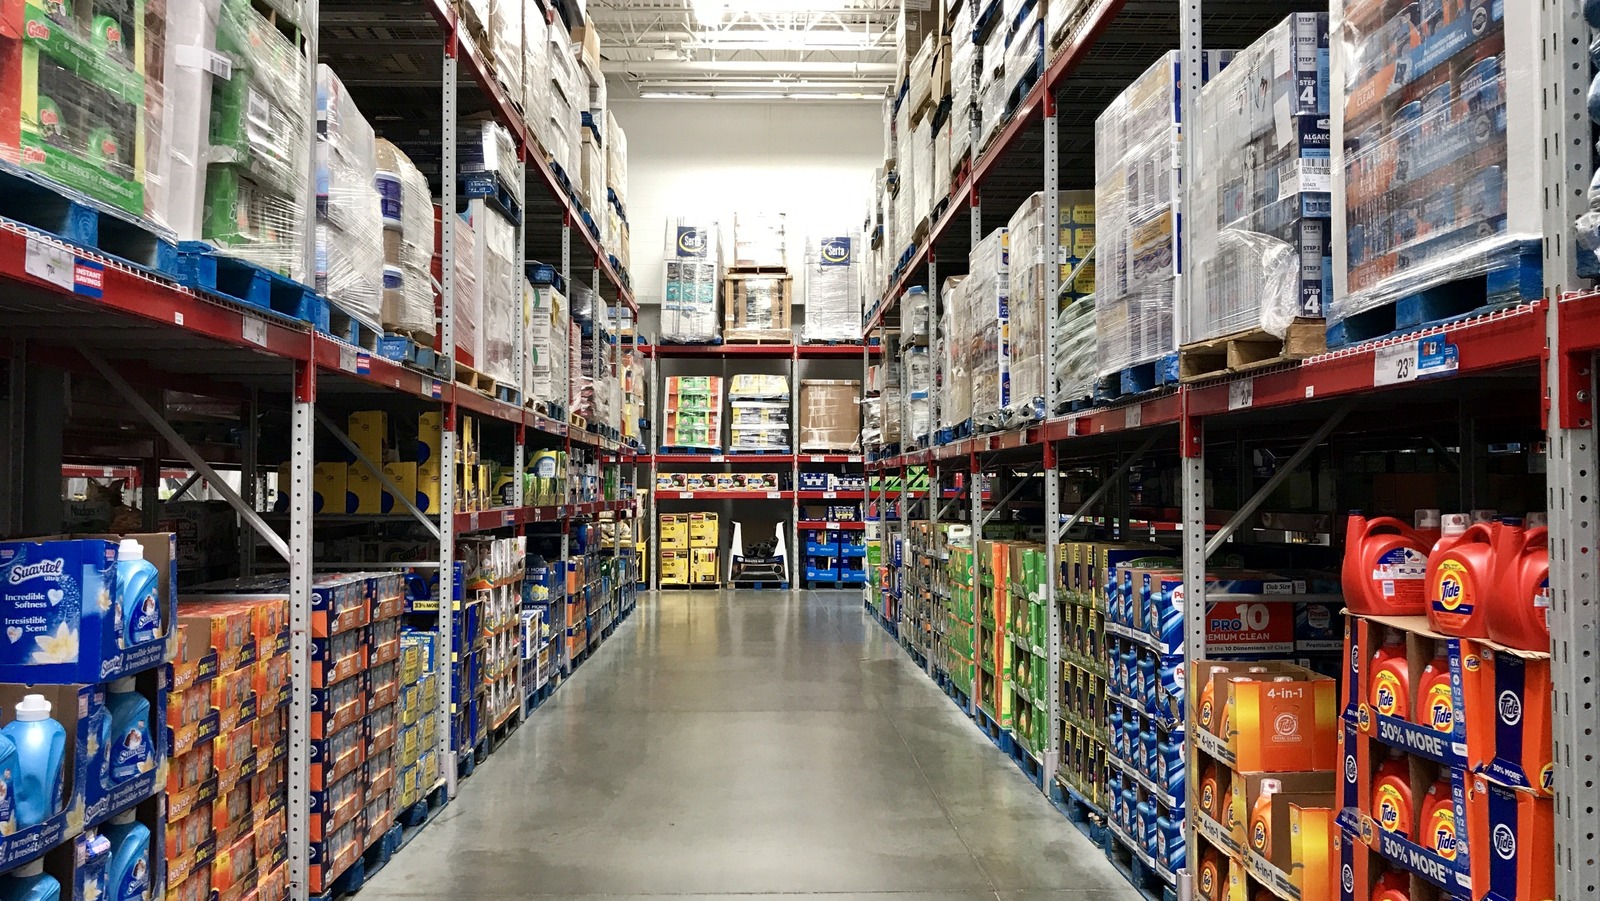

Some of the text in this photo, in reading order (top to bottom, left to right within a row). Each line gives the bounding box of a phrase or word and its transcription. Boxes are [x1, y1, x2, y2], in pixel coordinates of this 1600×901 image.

[1300, 86, 1316, 105] 4
[1357, 89, 1376, 106] CLEAN
[828, 245, 845, 257] Serta
[75, 267, 102, 280] INSTANT
[75, 274, 102, 287] SAVINGS
[1304, 294, 1320, 313] 4
[10, 559, 63, 584] Suavitel
[5, 592, 46, 602] Incredible
[1442, 580, 1460, 602] Tide
[14, 601, 47, 609] Softness
[5, 616, 47, 625] Irresistible
[1211, 618, 1242, 631] PRO
[1235, 603, 1270, 631] 10
[25, 624, 48, 633] Scent
[1239, 632, 1270, 640] CLEAN
[1451, 657, 1460, 667] 6X
[1466, 659, 1480, 668] Tide
[1267, 687, 1303, 699] 4-in-1
[1378, 690, 1394, 707] Tide
[1433, 706, 1452, 726] Tide
[1500, 699, 1520, 717] Tide
[1277, 718, 1296, 731] Tide
[1380, 721, 1404, 744] 30%
[1201, 735, 1216, 753] 4-in-1
[1543, 770, 1553, 789] Ti
[1453, 787, 1463, 798] 6X
[1381, 803, 1397, 822] Tide
[1203, 820, 1219, 839] 4-in-1
[1255, 827, 1264, 842] Tide
[1437, 830, 1457, 851] Tide
[1495, 830, 1514, 850] Tide
[1383, 836, 1408, 864] 30%
[1254, 860, 1273, 883] 4-in-1
